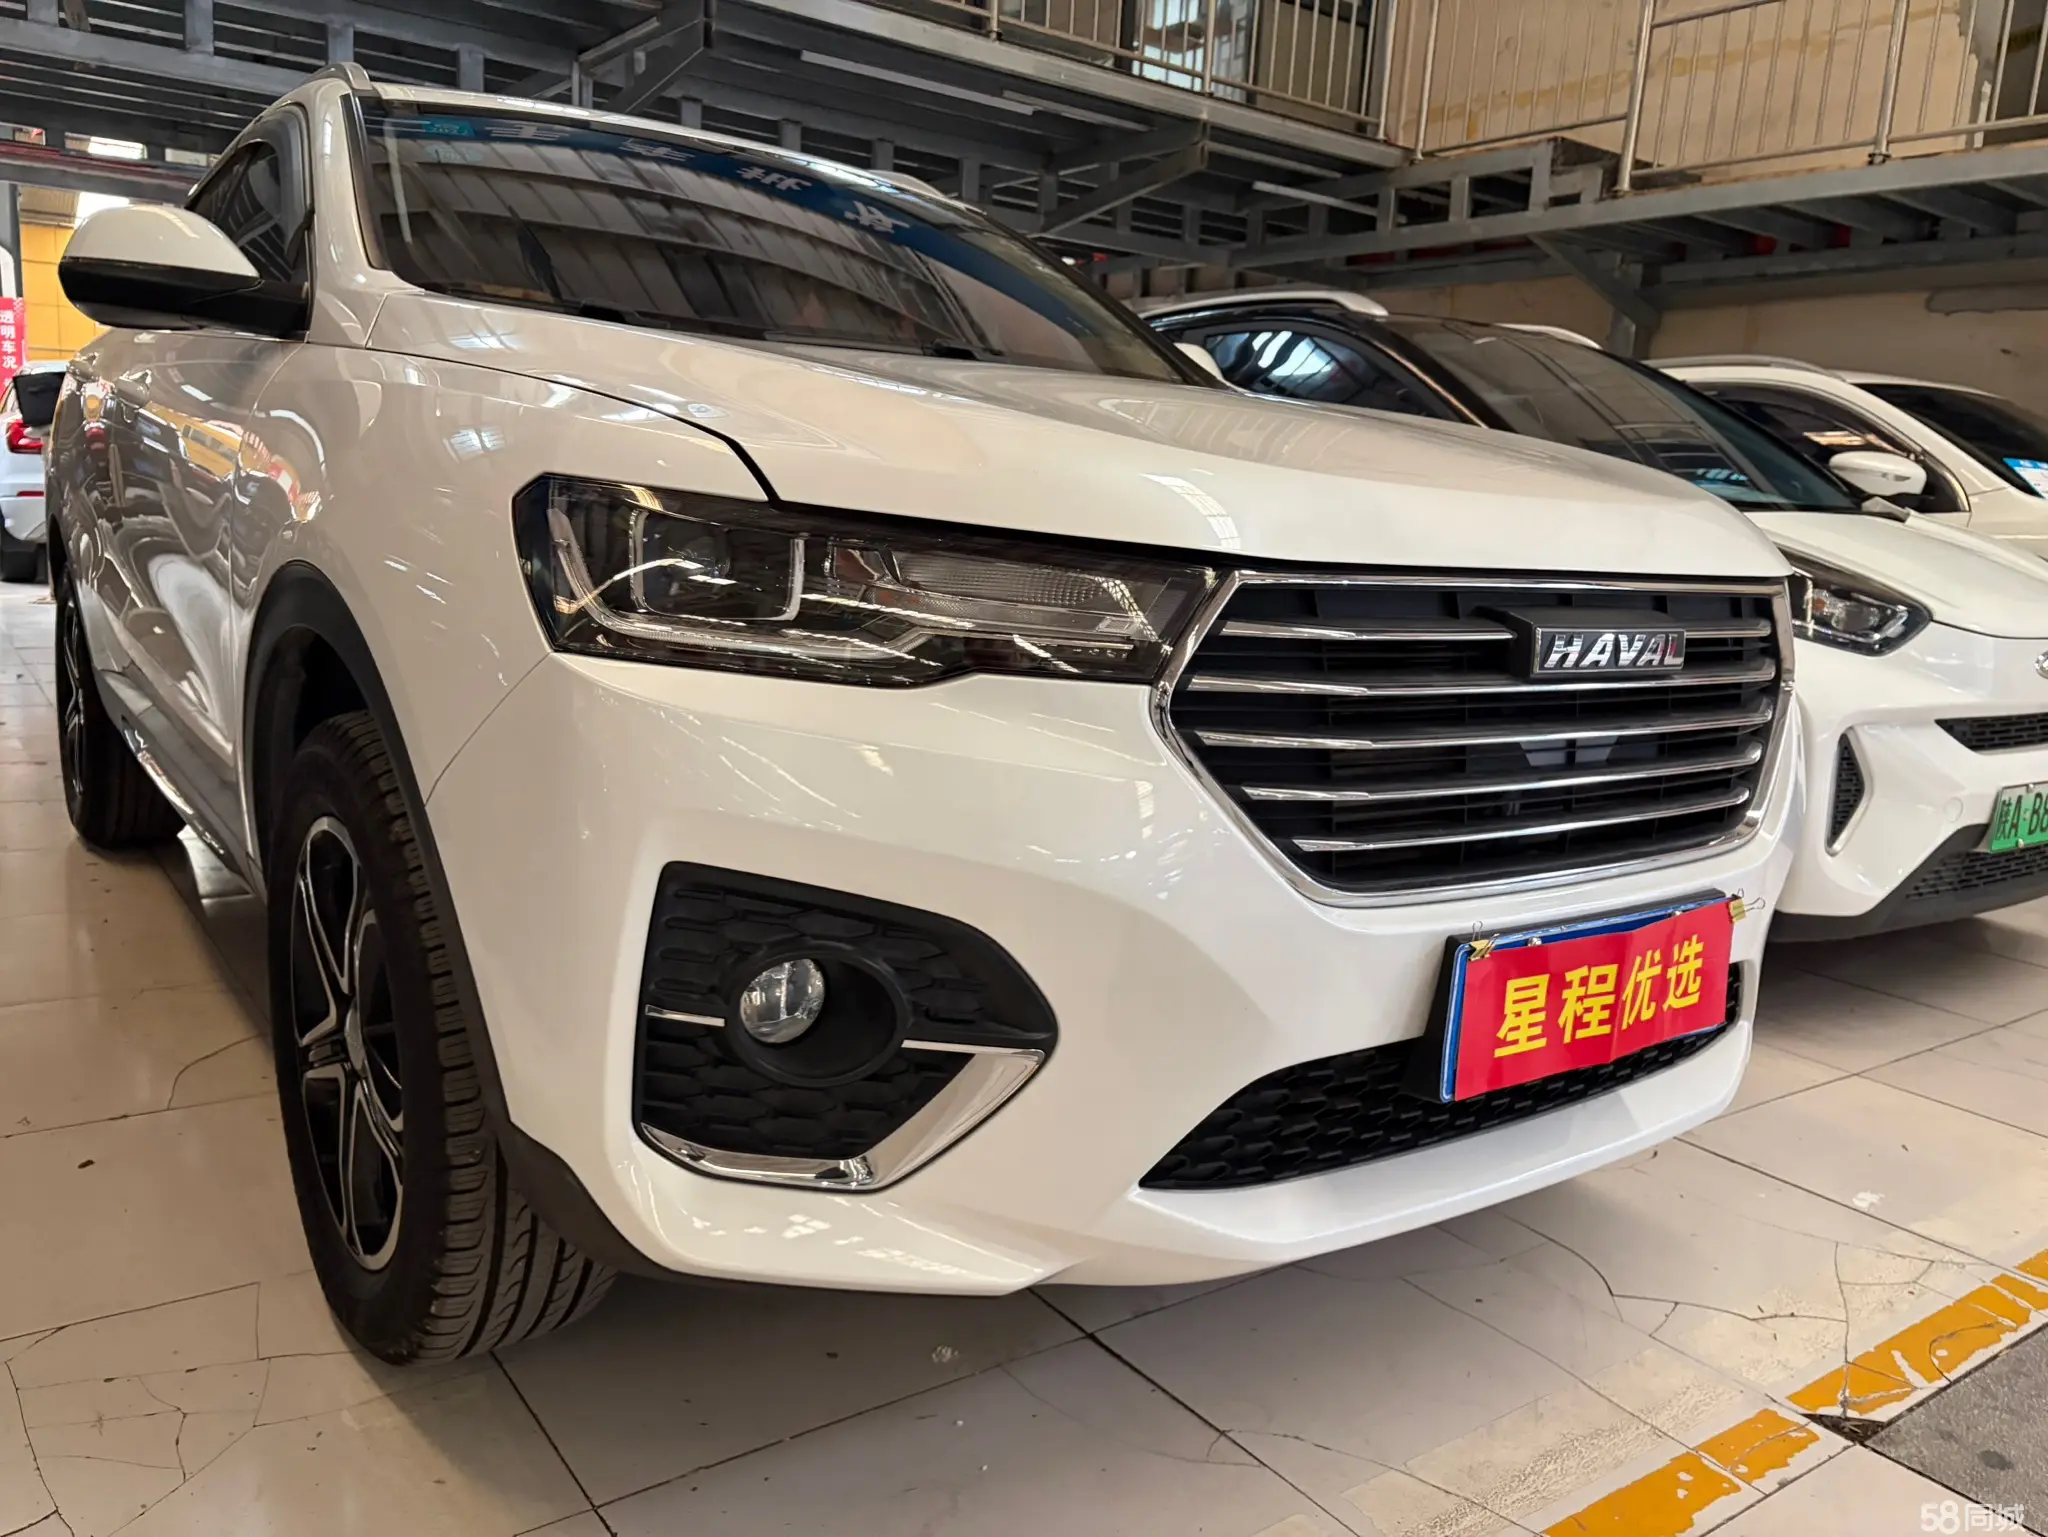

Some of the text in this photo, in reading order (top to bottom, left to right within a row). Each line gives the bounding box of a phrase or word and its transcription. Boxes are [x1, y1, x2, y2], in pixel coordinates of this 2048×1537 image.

[0, 310, 18, 369] 透明车况
[1544, 633, 1685, 668] HAVAL
[1494, 933, 1704, 1059] 星程优选
